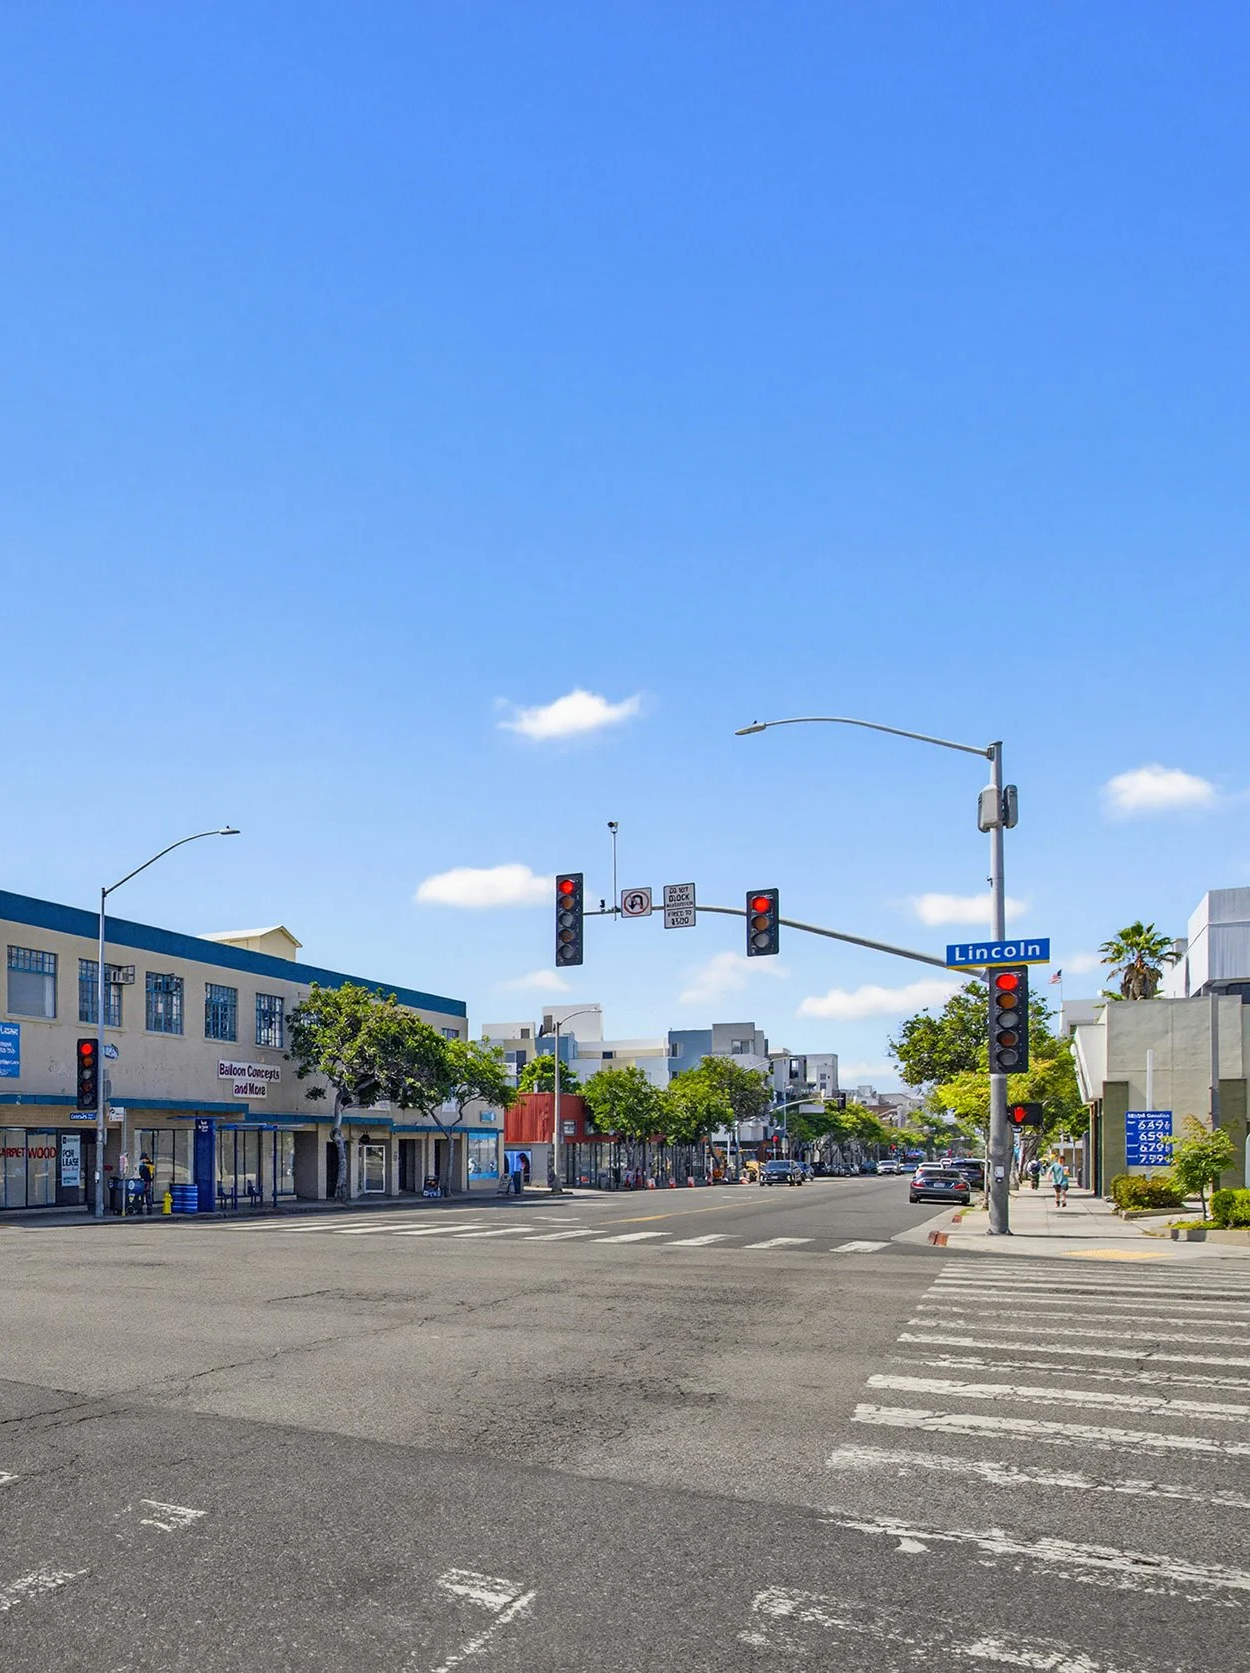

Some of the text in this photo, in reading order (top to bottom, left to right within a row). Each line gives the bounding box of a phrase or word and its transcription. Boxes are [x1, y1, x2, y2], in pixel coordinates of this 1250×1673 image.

[954, 942, 1041, 961] Lincoln
[219, 1063, 280, 1081] Balloon Concepts
[234, 1083, 266, 1096] and More
[27, 1147, 57, 1159] WOOD
[62, 1149, 75, 1158] FOR
